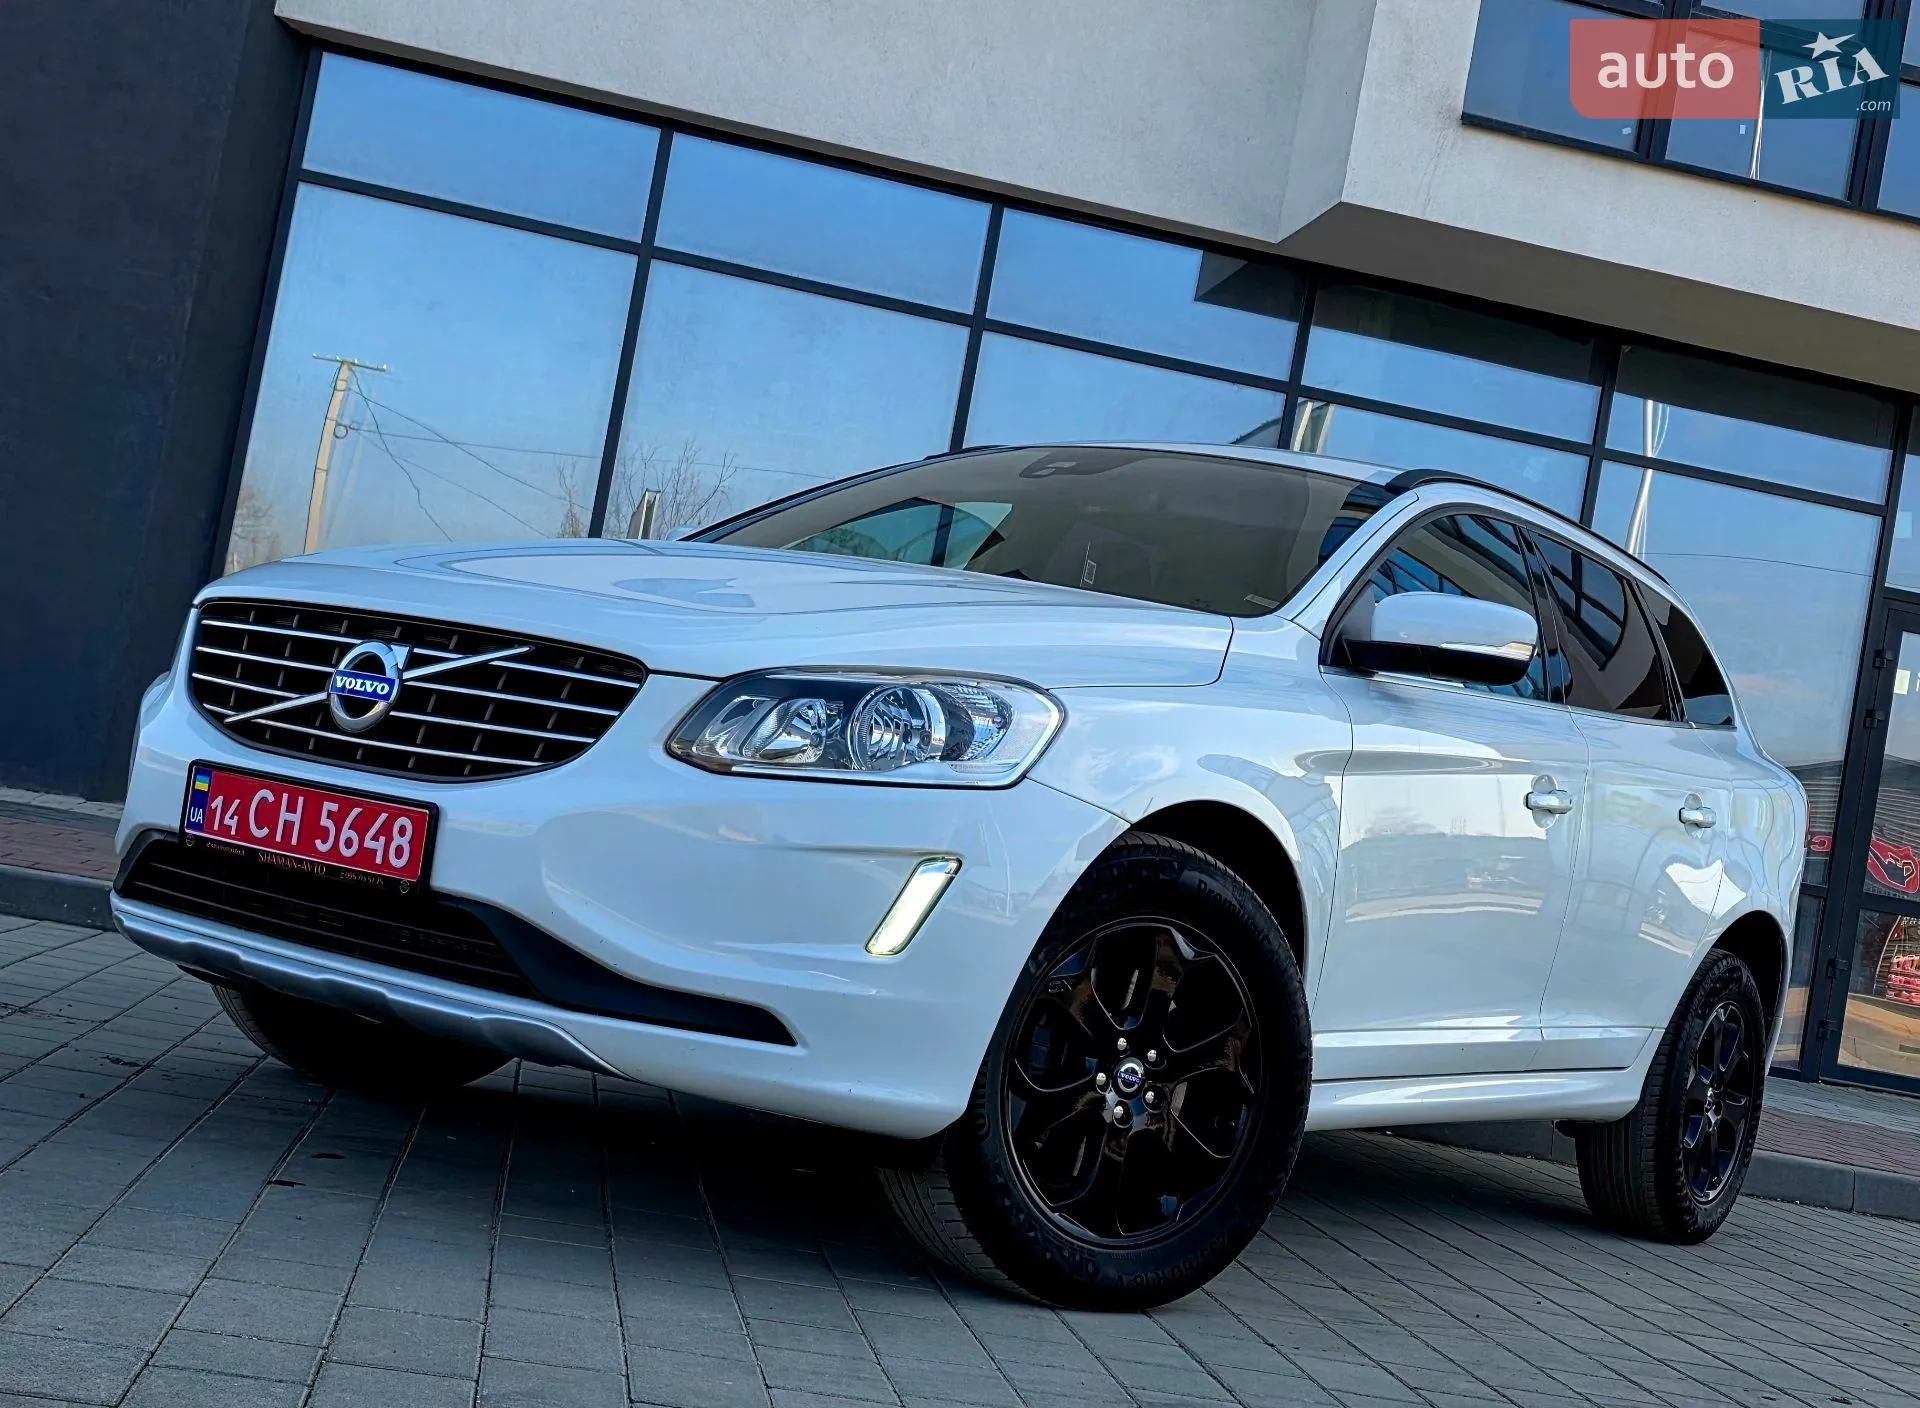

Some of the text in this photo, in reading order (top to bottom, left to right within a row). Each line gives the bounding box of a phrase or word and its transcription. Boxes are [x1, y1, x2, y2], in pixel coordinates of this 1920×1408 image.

[335, 675, 390, 695] VOLVO
[190, 806, 203, 824] UA
[210, 788, 413, 869] 14 CH 5648
[1120, 1072, 1141, 1083] VOLVO
